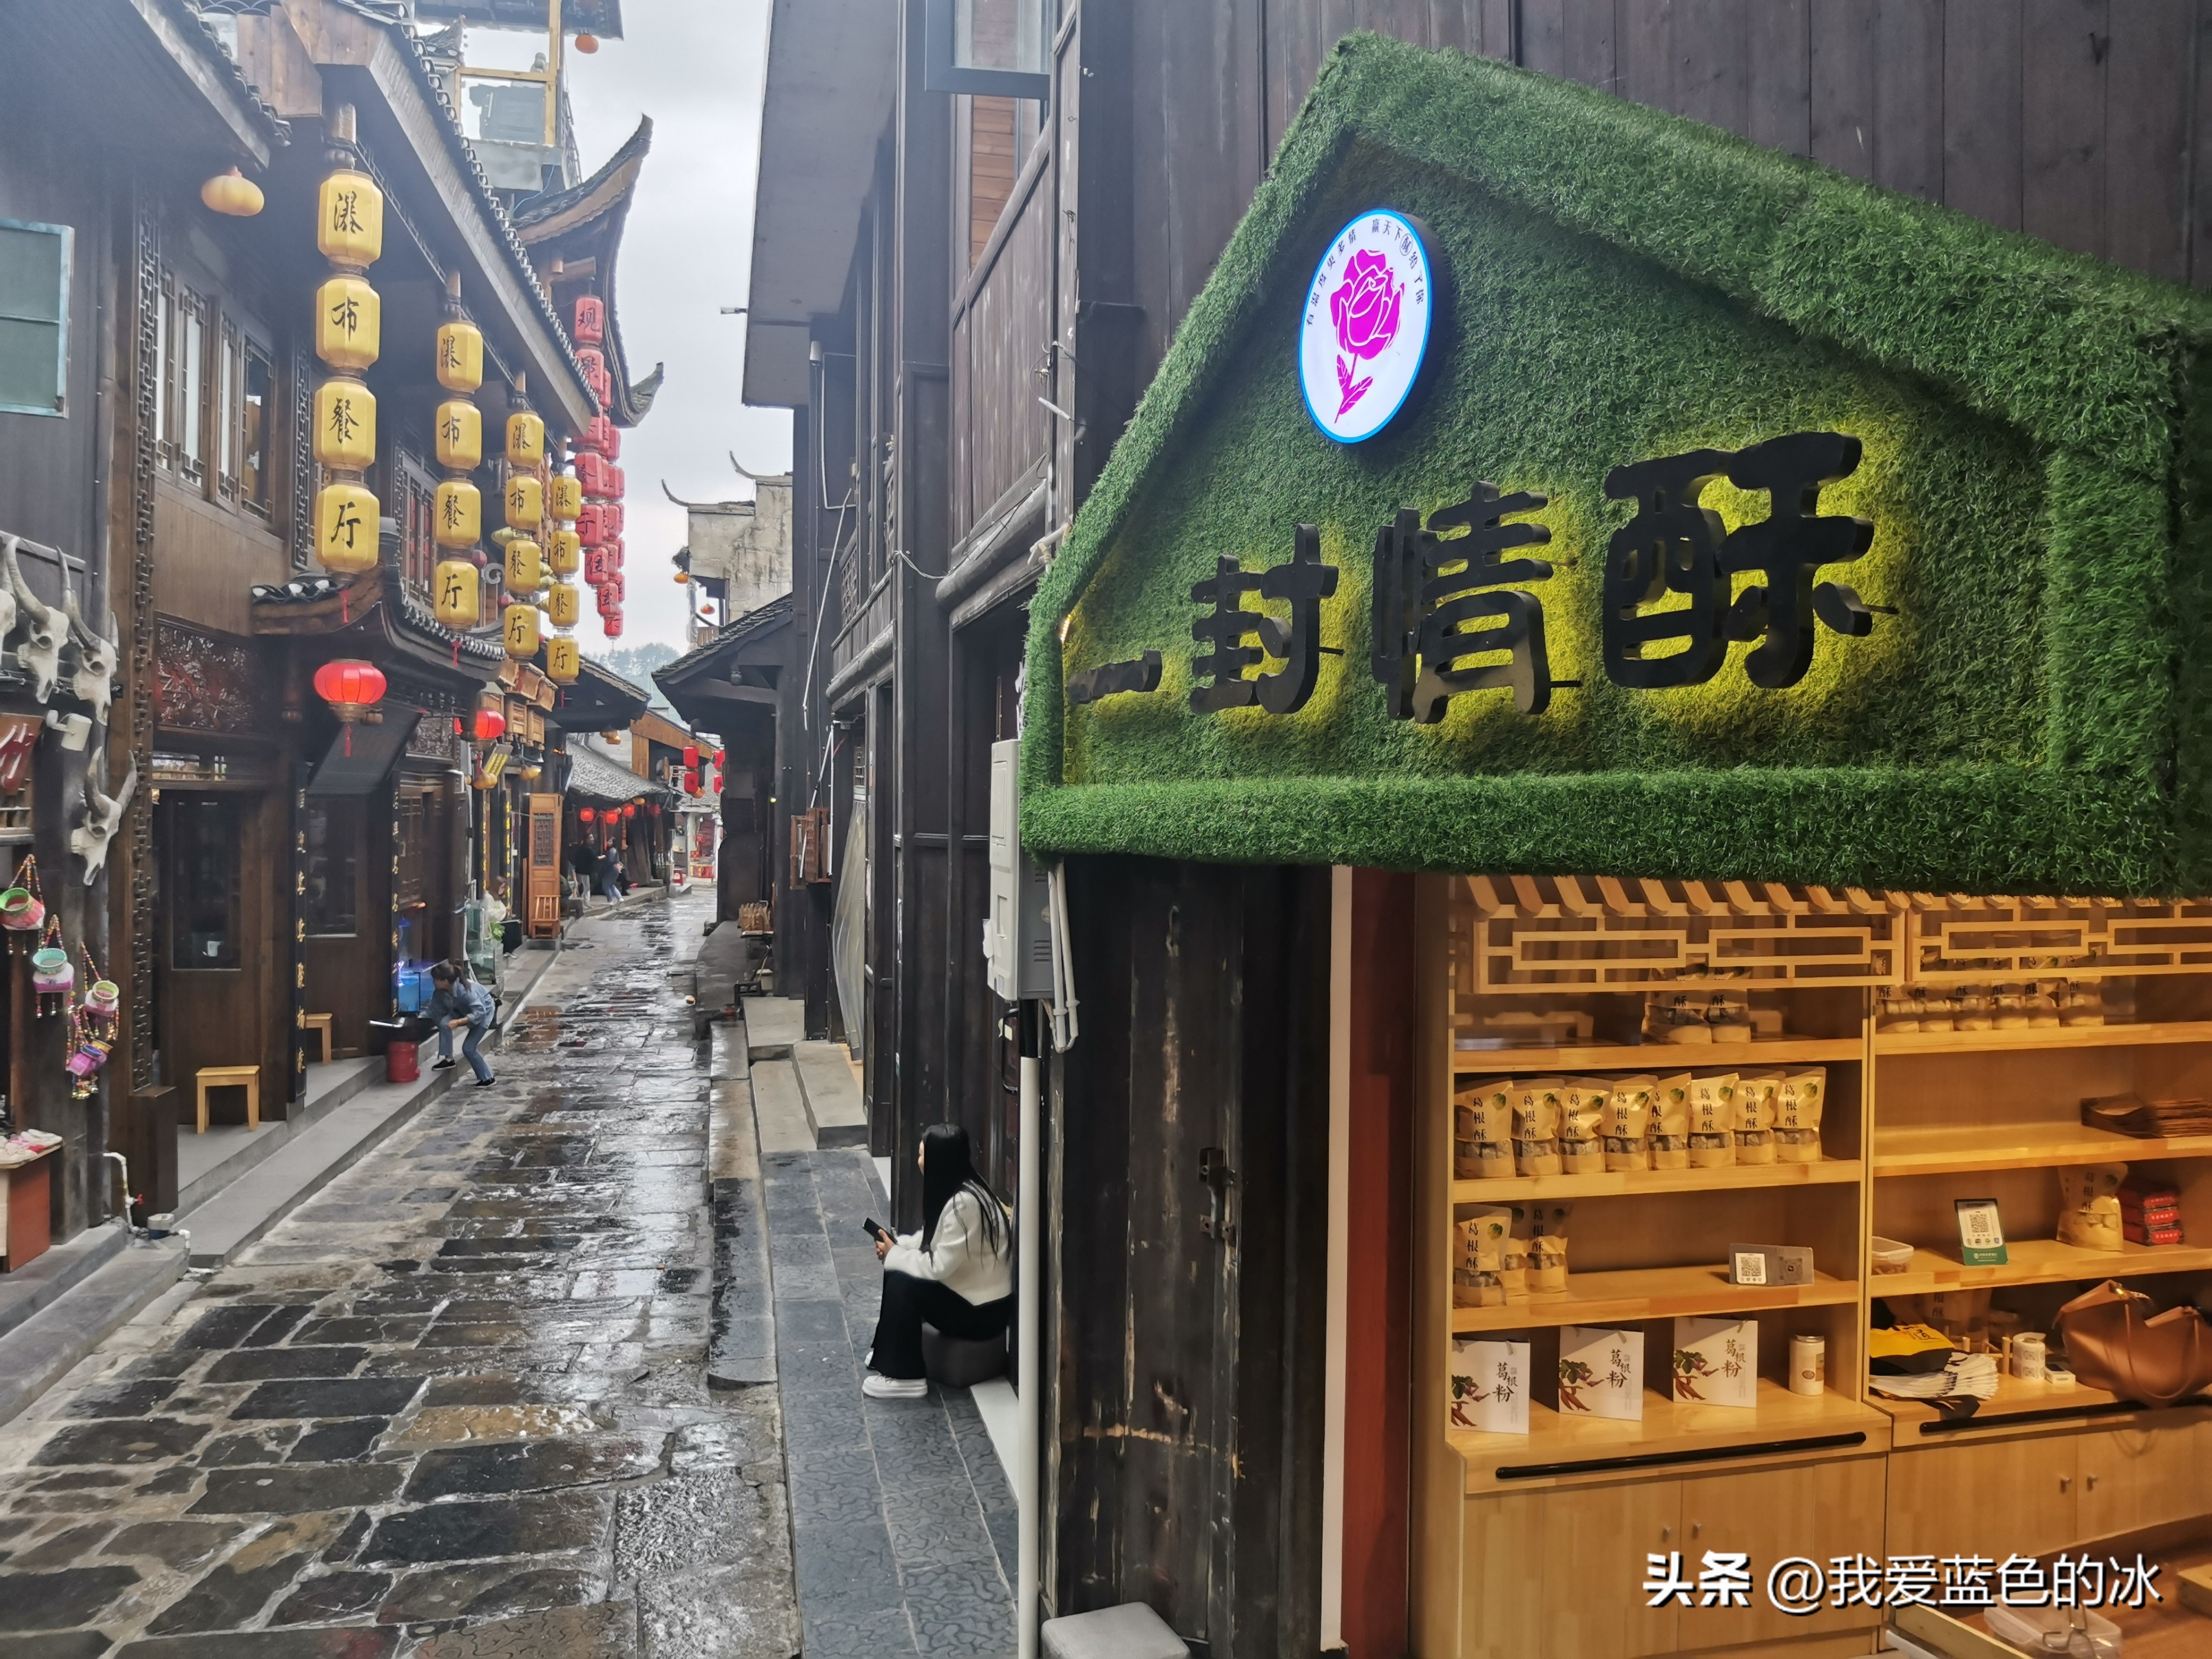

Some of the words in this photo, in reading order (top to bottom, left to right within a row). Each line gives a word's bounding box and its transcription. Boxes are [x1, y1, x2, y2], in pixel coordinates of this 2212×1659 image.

[331, 193, 363, 548] 瀑布餐厅
[441, 336, 464, 610] 瀑布餐厅
[508, 423, 531, 644] 瀑布餐厅
[553, 487, 571, 670] 瀑布餐厅
[1070, 431, 1874, 724] 一封情酥
[1473, 1097, 1487, 1141] 葛根酥
[1524, 1095, 1537, 1139] 葛根酥
[1567, 1094, 1580, 1137] 葛根酥
[1615, 1092, 1628, 1136] 葛根酥
[1700, 1087, 1714, 1131] 葛根酥
[1745, 1086, 1758, 1129] 葛根酥
[1784, 1084, 1798, 1127] 葛根酥
[1606, 1349, 1632, 1389] 葛根粉
[1720, 1339, 1746, 1378] 葛根粉
[1492, 1362, 1518, 1403] 葛根粉
